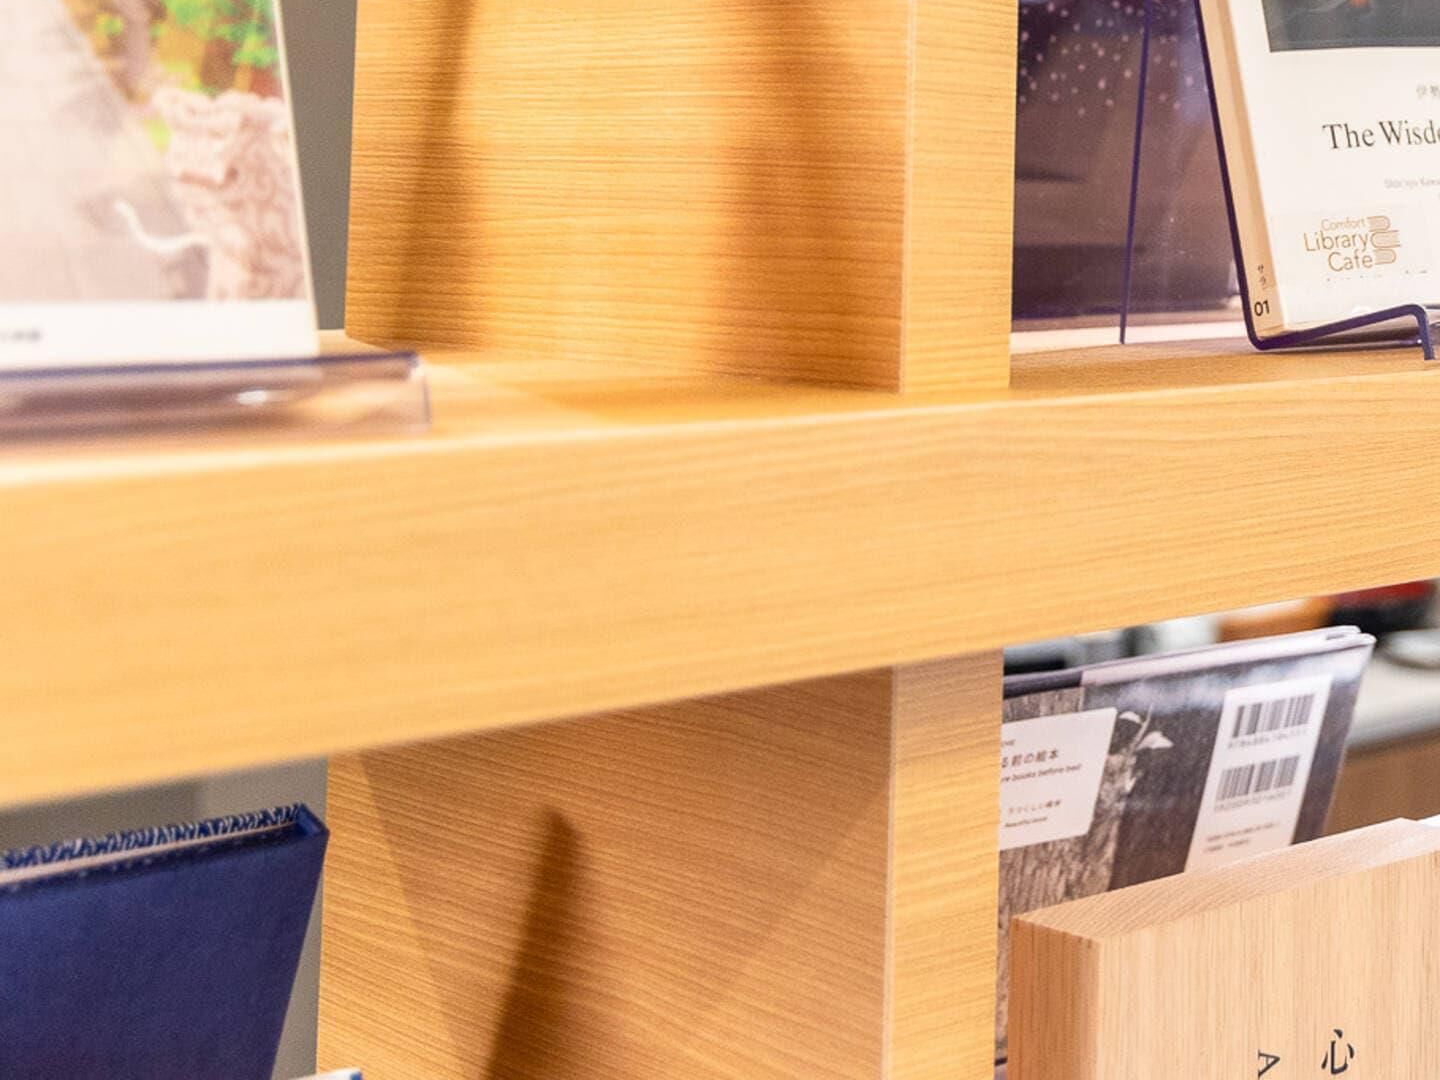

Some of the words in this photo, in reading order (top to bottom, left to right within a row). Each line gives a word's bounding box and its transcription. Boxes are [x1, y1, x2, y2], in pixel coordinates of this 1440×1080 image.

[1322, 123, 1376, 150] The
[1321, 218, 1366, 232] Comfort
[1303, 231, 1370, 252] Library
[1328, 249, 1373, 272] Cafe
[1254, 300, 1270, 317] 01
[1321, 1029, 1354, 1075] 心
